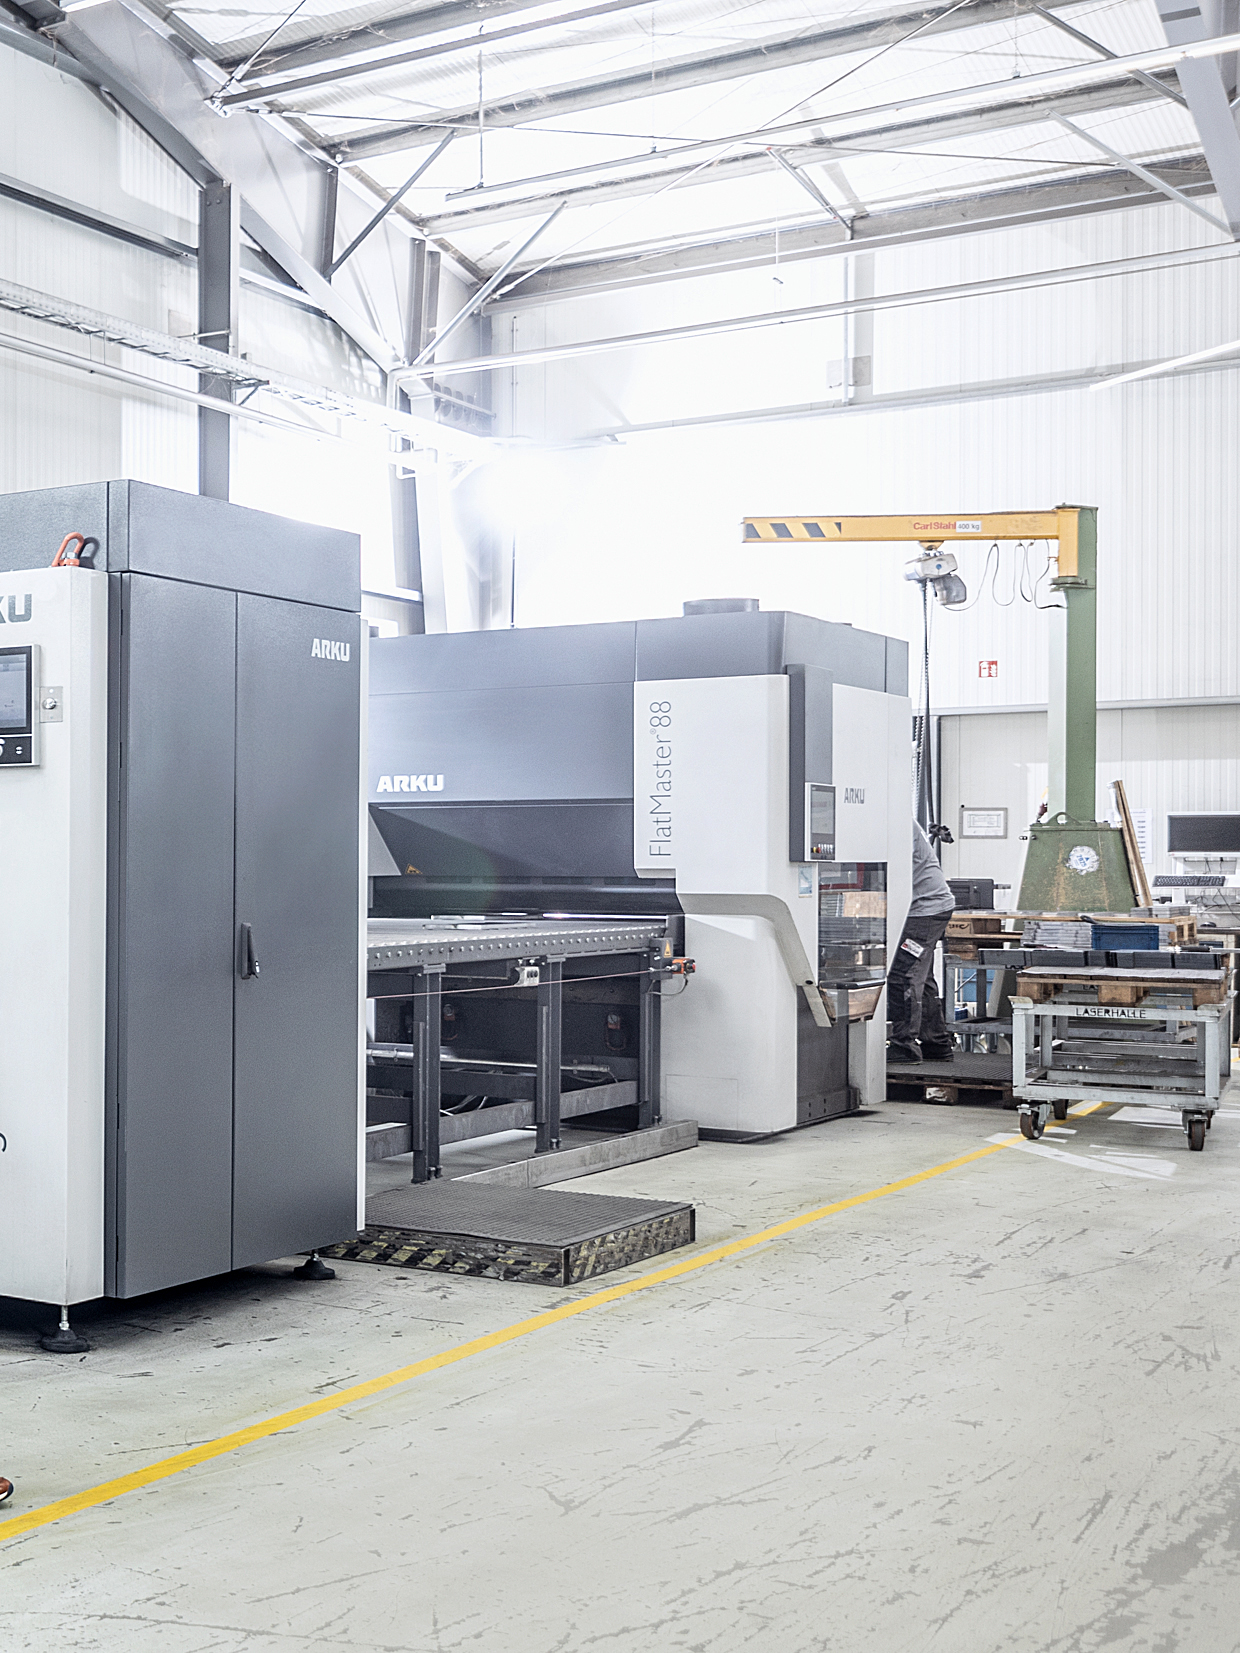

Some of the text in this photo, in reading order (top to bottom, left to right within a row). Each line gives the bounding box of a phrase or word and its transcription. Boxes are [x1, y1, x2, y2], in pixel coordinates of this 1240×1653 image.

[913, 521, 957, 530] Carl Stahl
[971, 523, 980, 531] kg
[311, 638, 350, 662] ARKU
[649, 701, 672, 727] 88
[376, 774, 444, 792] ARKU
[844, 788, 865, 804] ARKU
[1076, 1007, 1146, 1018] LASERHALLE
